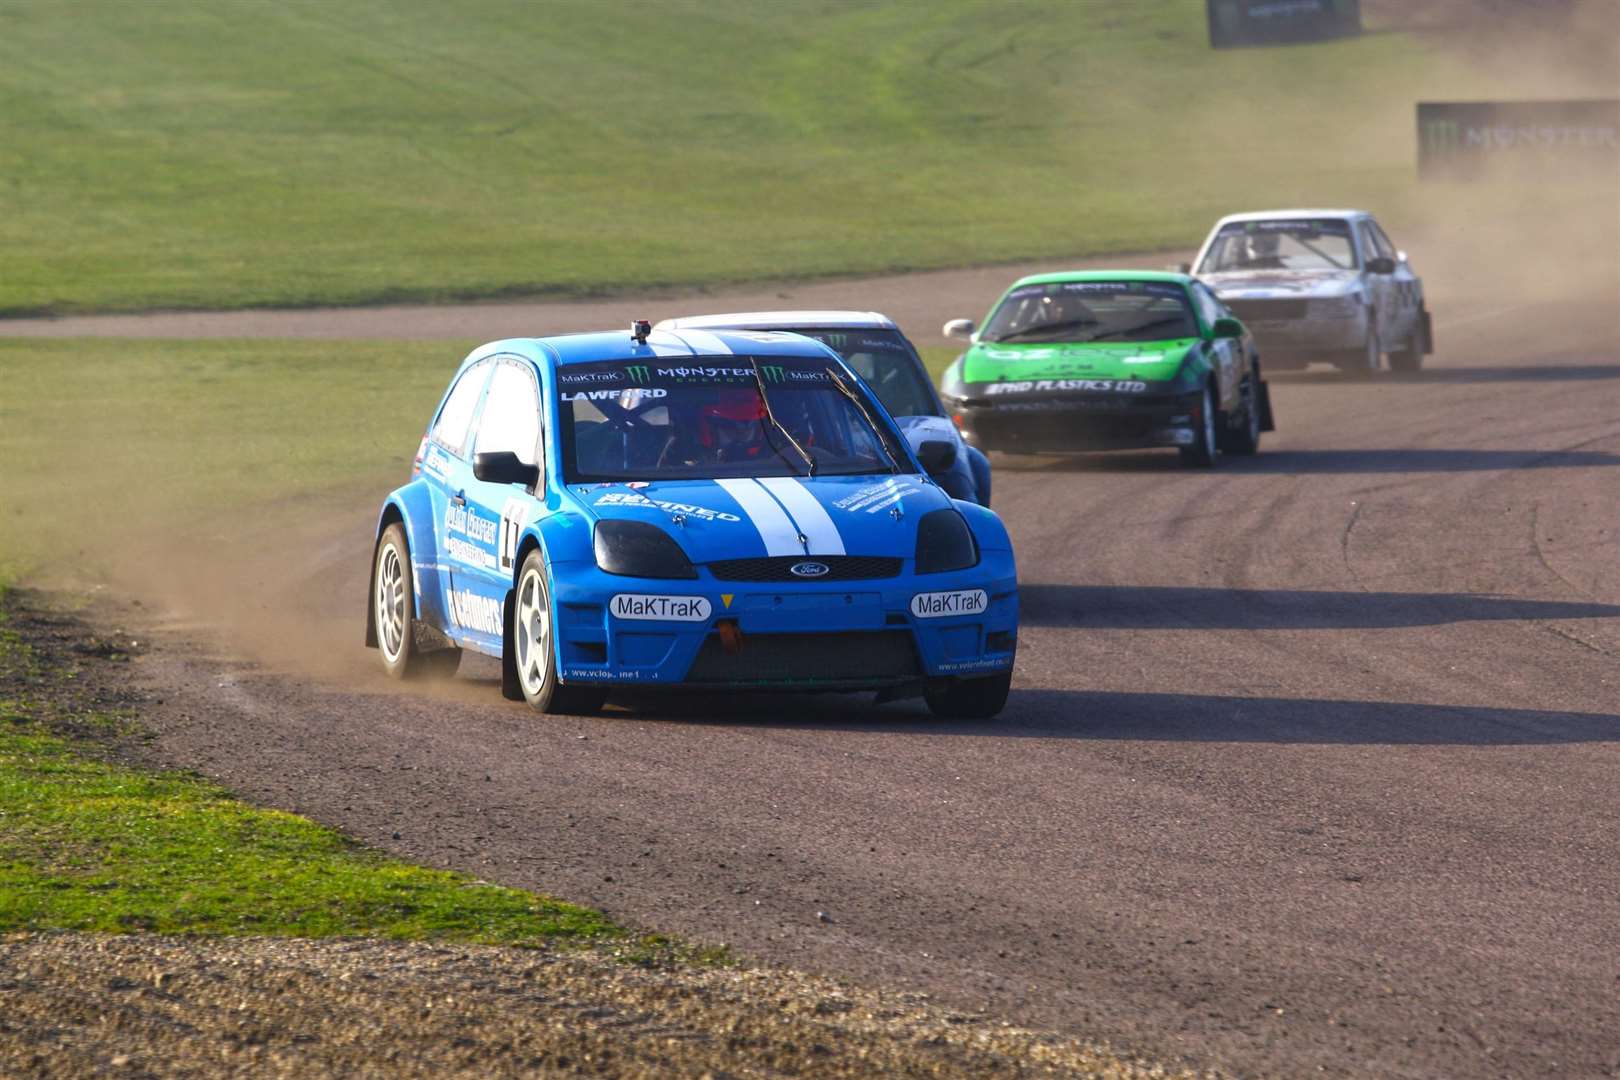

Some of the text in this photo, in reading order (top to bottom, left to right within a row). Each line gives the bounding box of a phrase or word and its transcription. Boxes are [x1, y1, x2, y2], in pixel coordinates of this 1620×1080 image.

[791, 371, 849, 383] MaKTrK
[1035, 379, 1113, 392] PLASTICS
[1115, 380, 1147, 393] LTD
[617, 597, 703, 617] MaKTraK
[917, 591, 983, 614] MaKTraK
